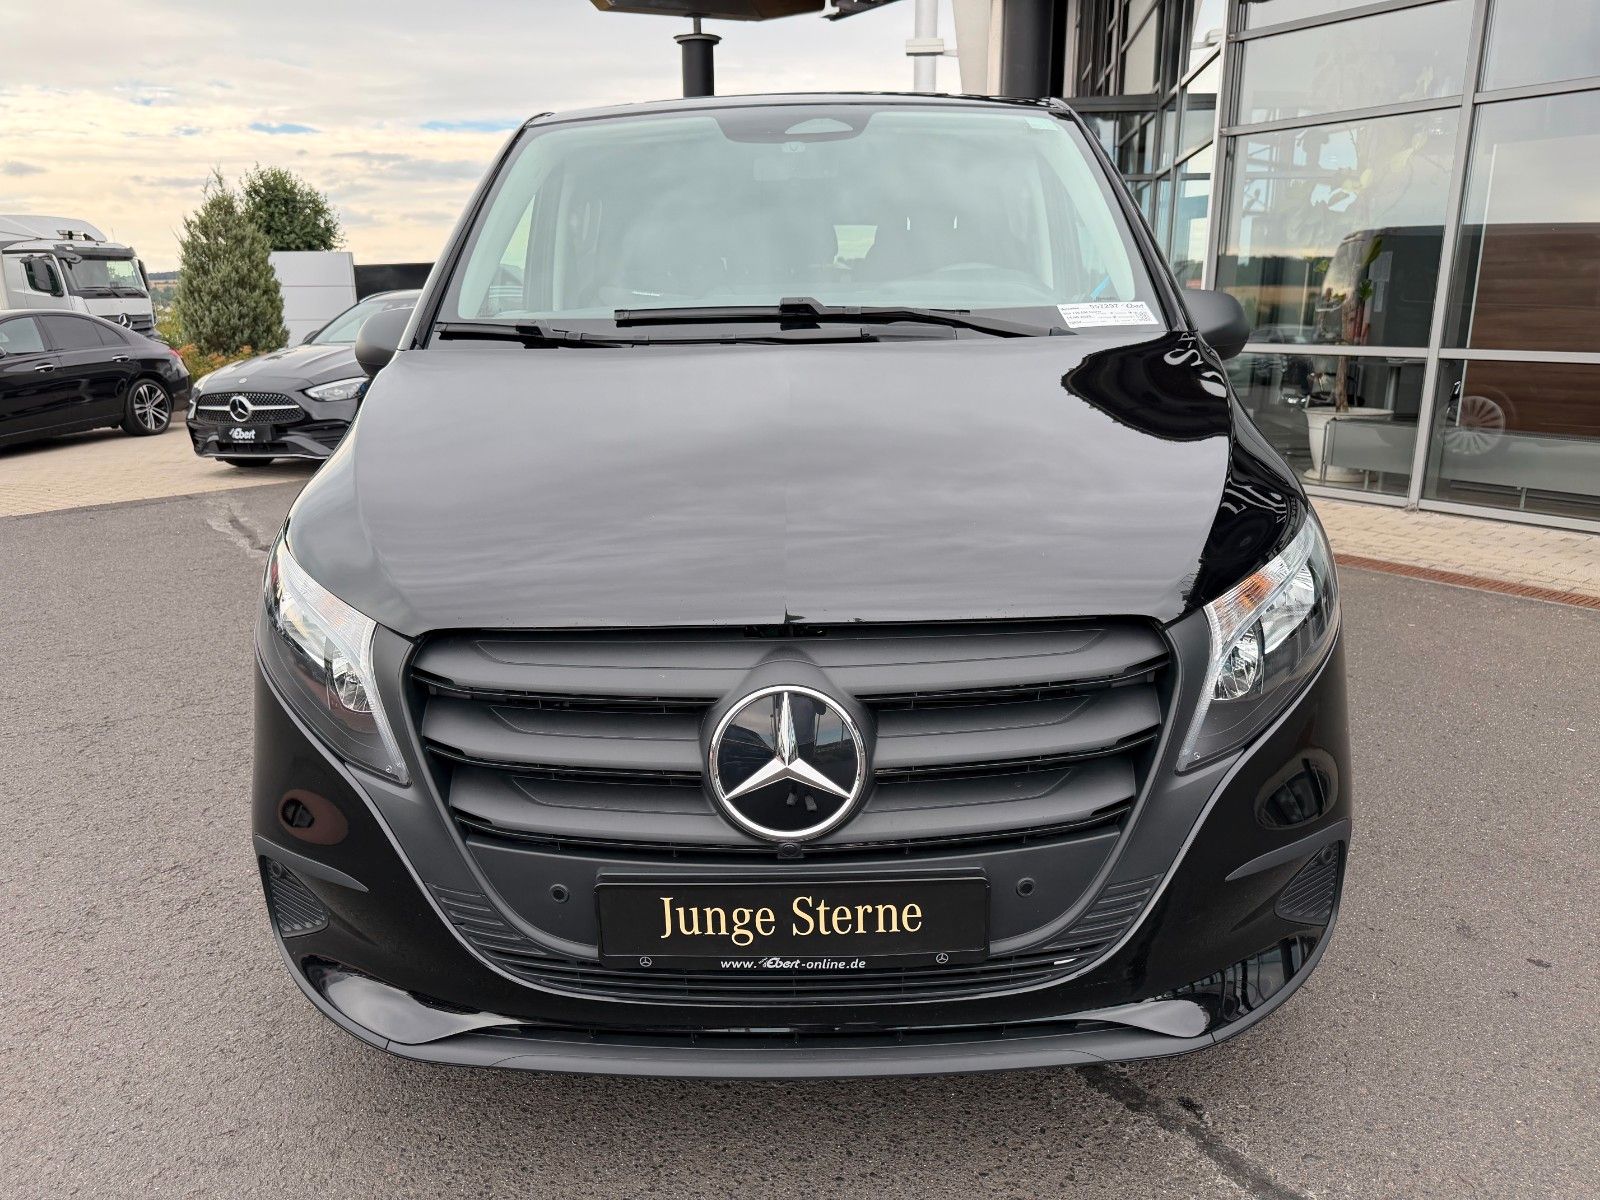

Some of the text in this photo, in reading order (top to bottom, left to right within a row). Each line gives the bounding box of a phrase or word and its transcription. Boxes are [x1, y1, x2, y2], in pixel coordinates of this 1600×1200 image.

[232, 427, 256, 440] Ebert
[659, 895, 922, 947] Junge Sterne
